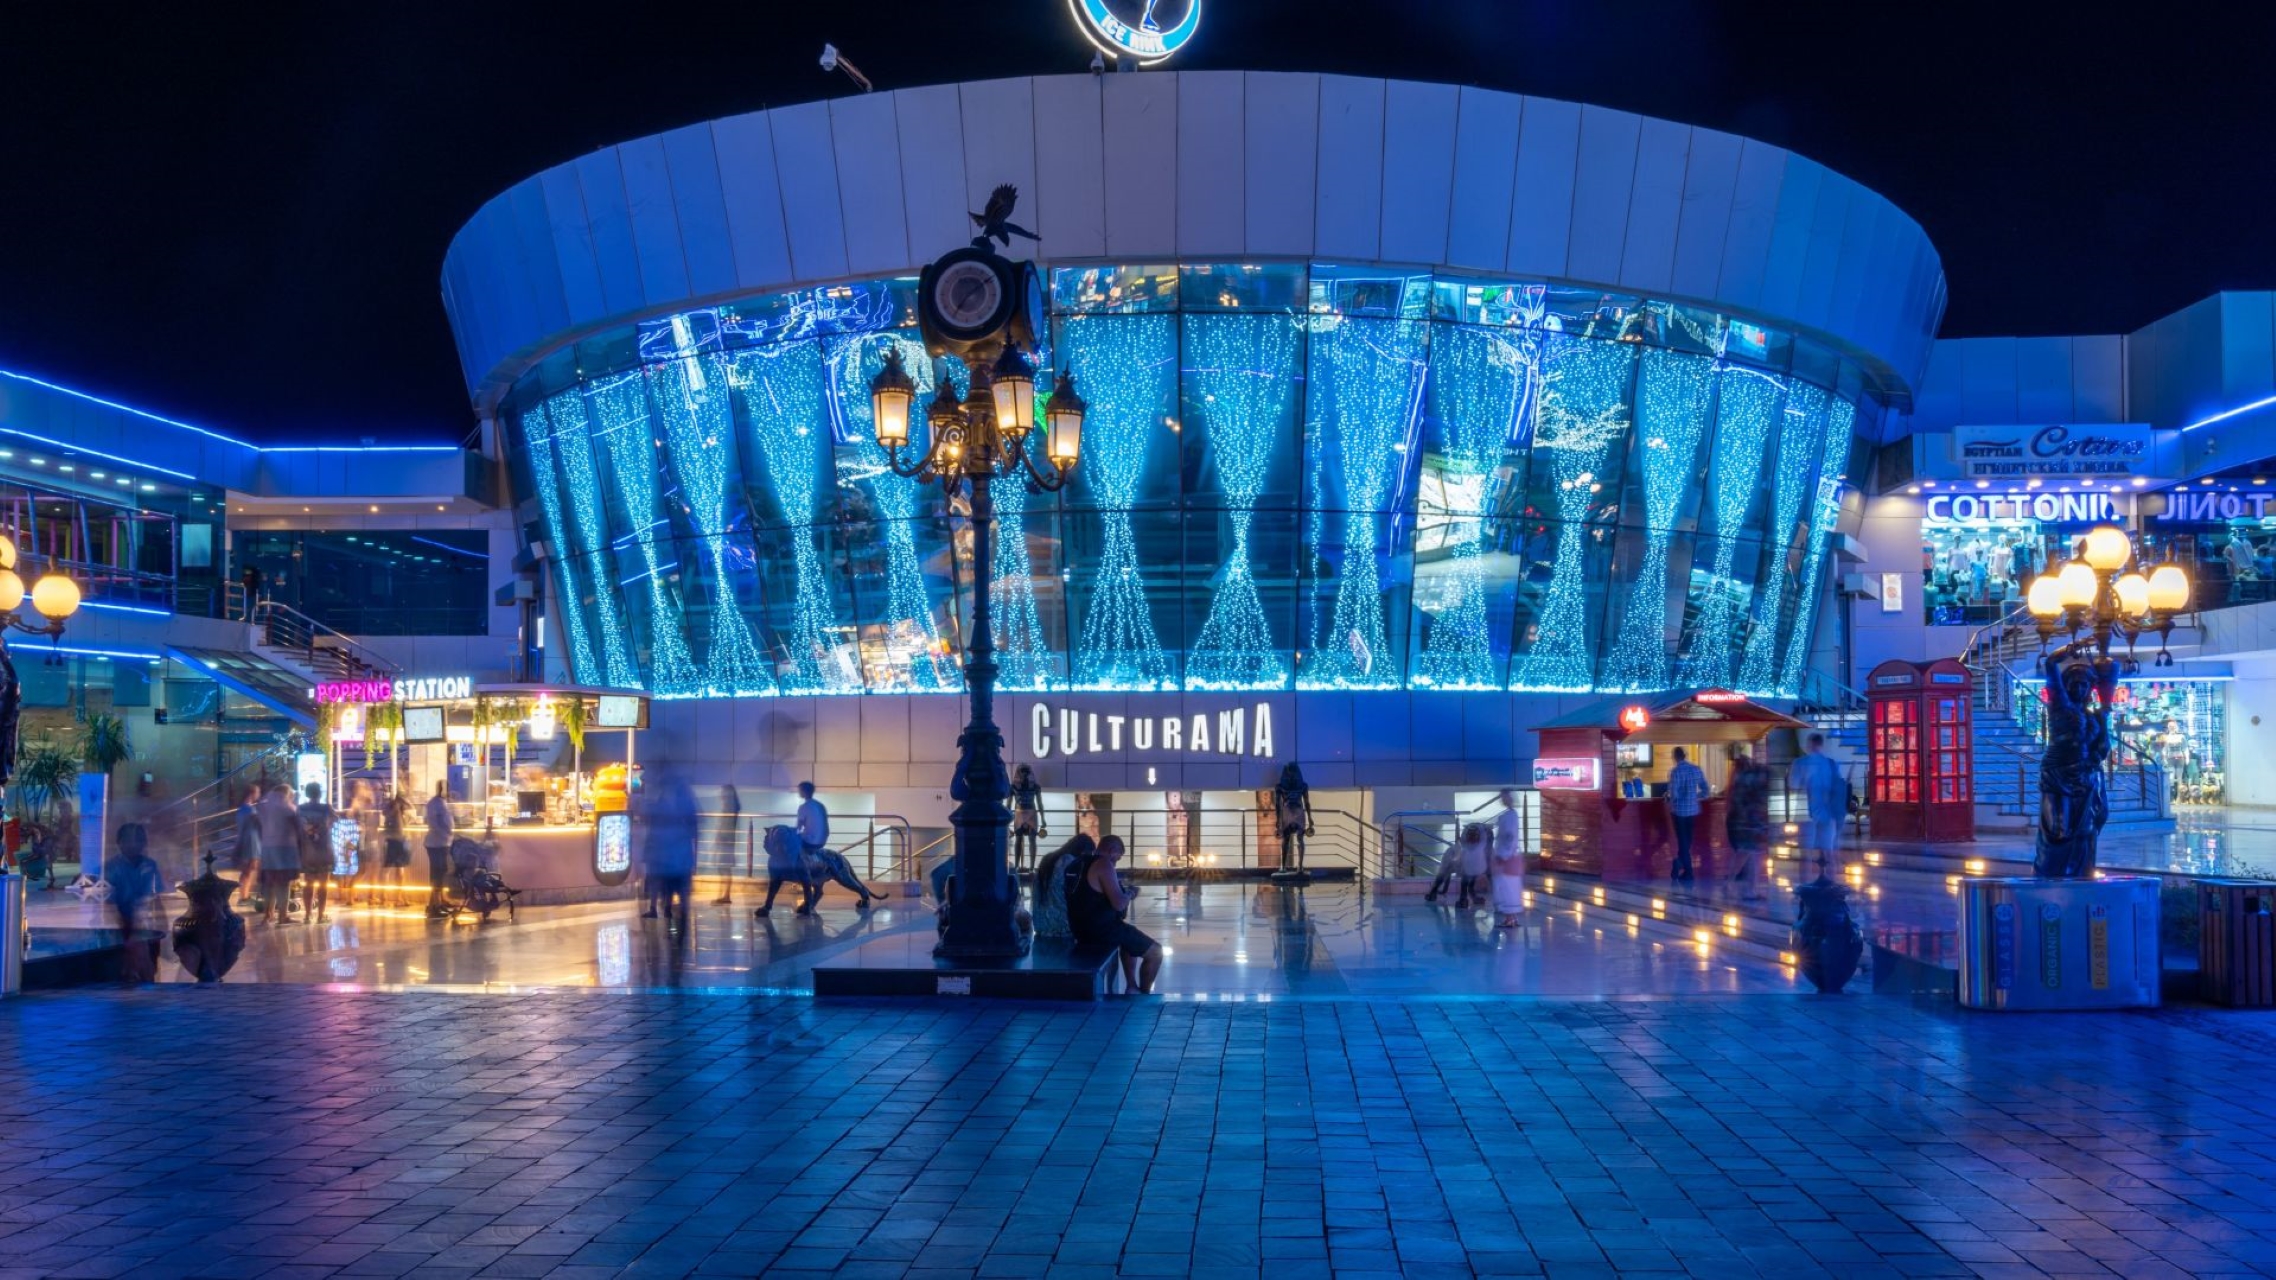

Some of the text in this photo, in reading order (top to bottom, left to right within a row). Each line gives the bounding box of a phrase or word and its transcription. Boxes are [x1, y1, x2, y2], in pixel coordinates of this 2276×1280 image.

[1100, 14, 1127, 42] ICE
[1927, 494, 2120, 522] COTTONIL
[317, 677, 470, 702] POPPING STATION
[1032, 702, 1274, 758] CULTURAMA
[1999, 925, 2011, 987] GLASS
[2047, 926, 2059, 987] ORGANIC
[2093, 926, 2106, 987] PLASTIC
